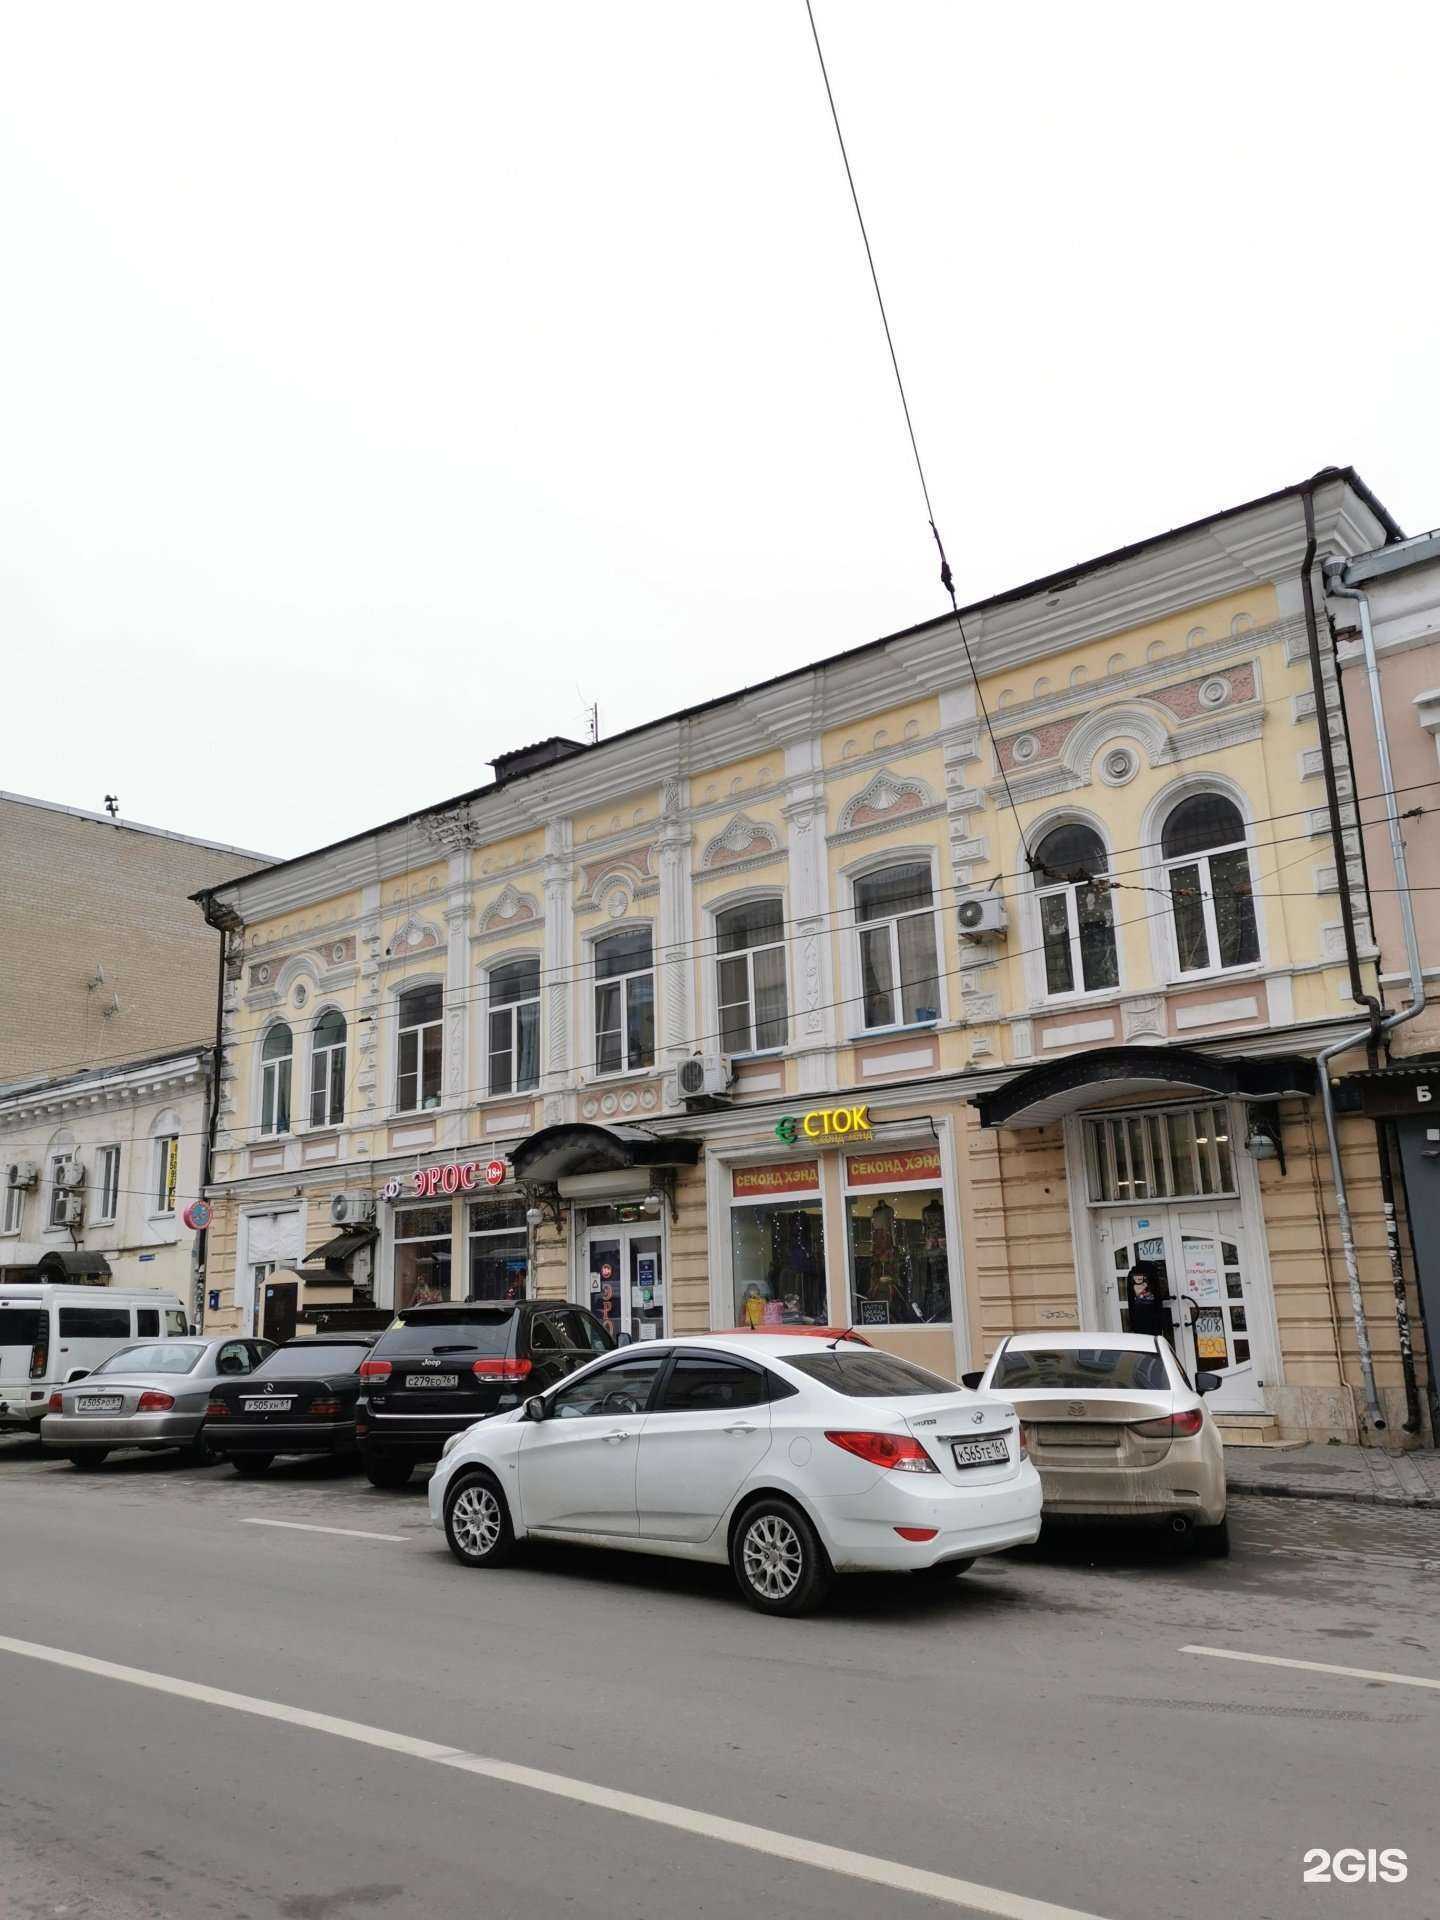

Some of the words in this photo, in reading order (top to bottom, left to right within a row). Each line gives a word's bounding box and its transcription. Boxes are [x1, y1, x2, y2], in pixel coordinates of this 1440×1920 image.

[804, 1104, 871, 1137] СТОК
[851, 1159, 904, 1176] СЕКОНД
[905, 1152, 940, 1170] ХЭНД
[412, 1163, 478, 1197] ЭРОС
[487, 1167, 501, 1179] 18+
[736, 1172, 783, 1187] СЕКОНД
[784, 1168, 818, 1184] ХЭНД
[422, 1359, 441, 1367] Jeep
